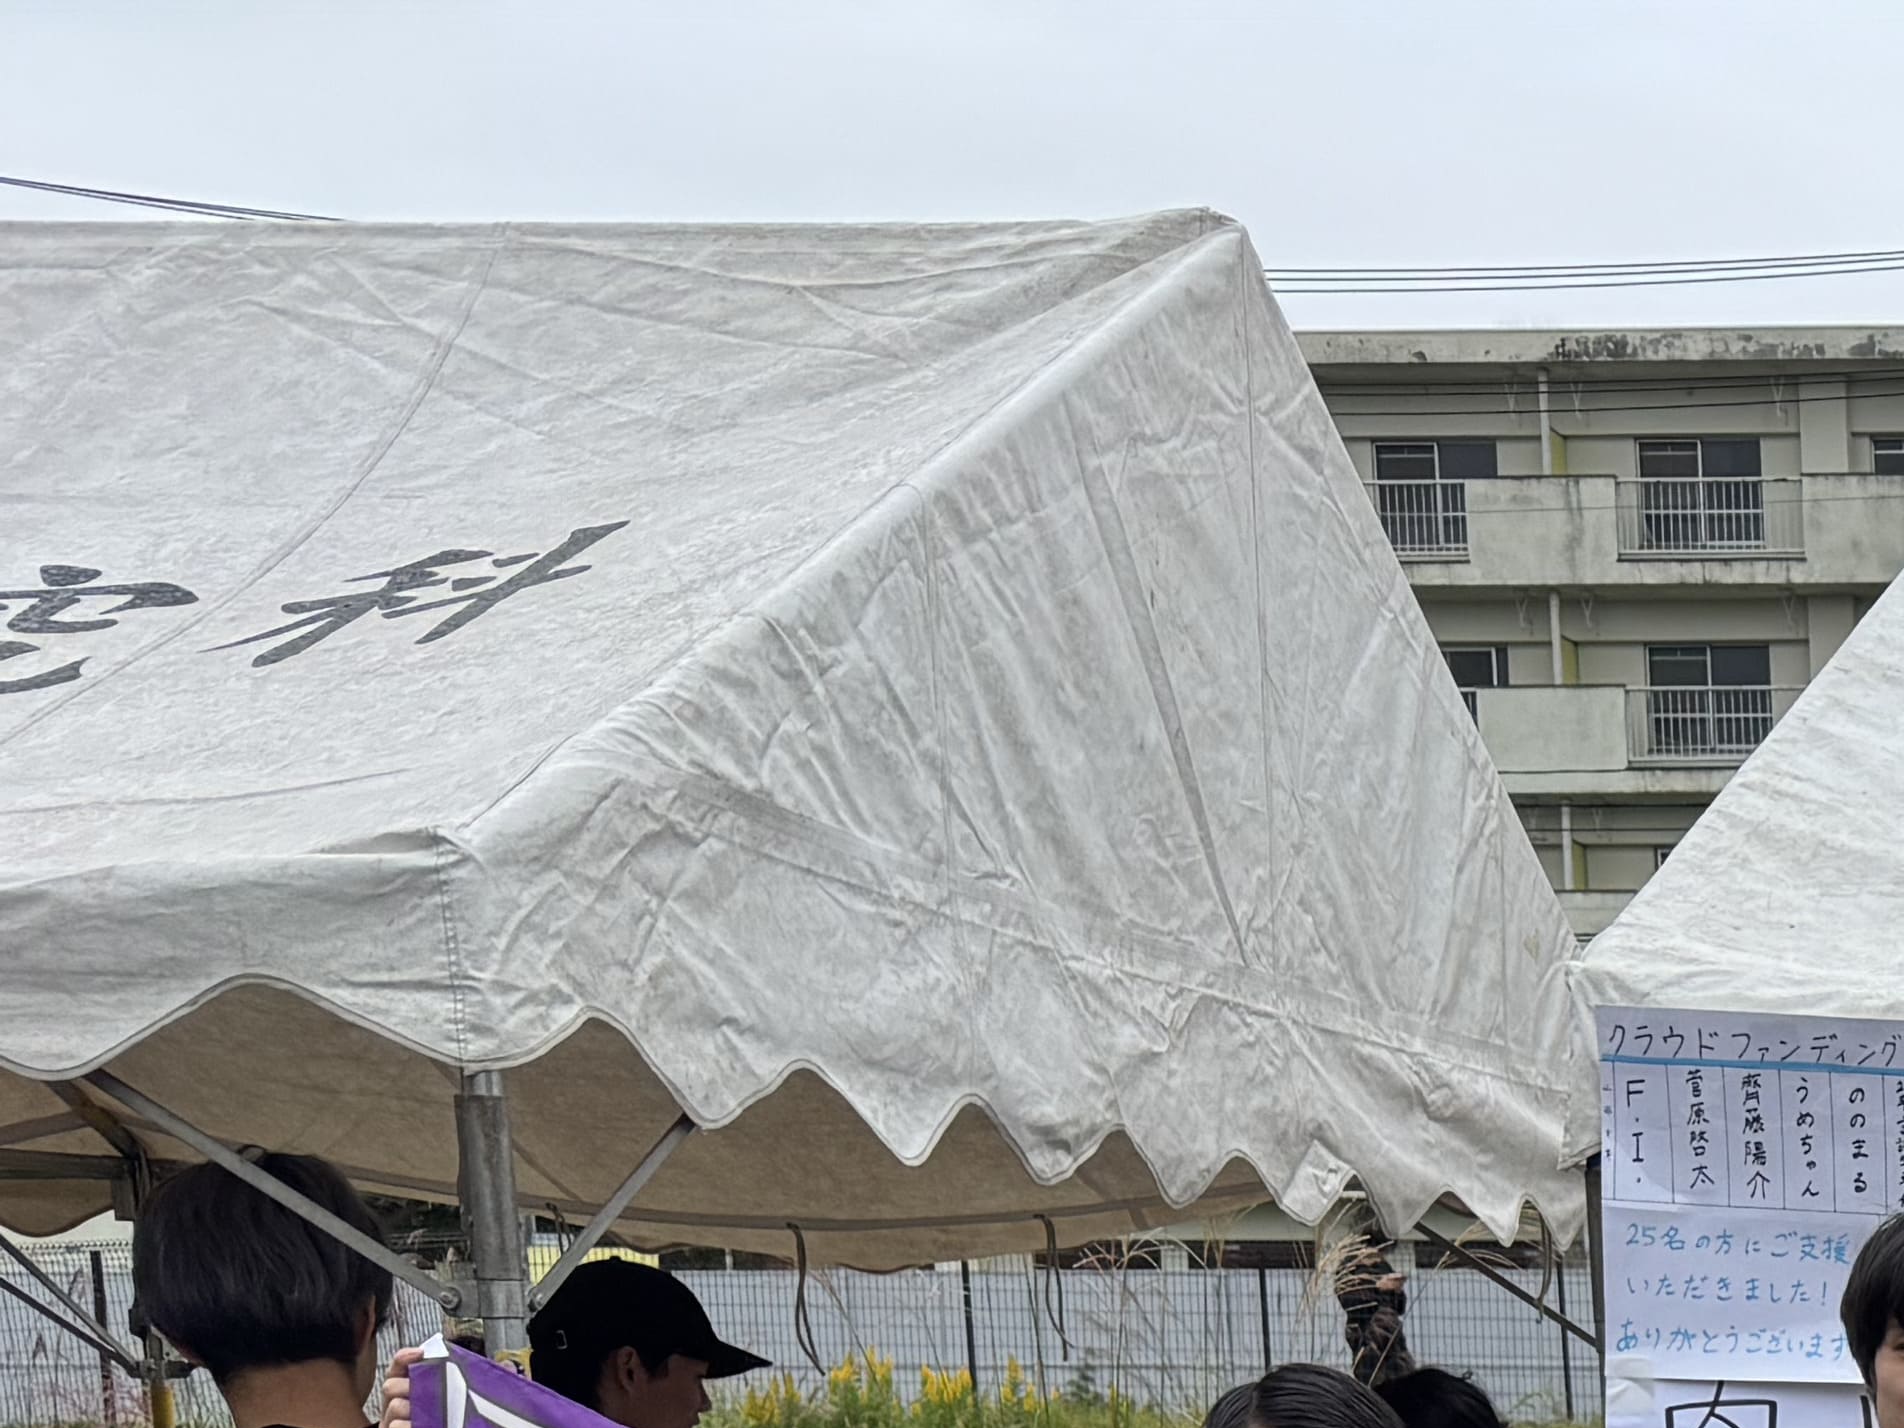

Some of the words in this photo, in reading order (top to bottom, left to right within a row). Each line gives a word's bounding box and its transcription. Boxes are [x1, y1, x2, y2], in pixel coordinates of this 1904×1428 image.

[1796, 1077, 1819, 1197] うめちゃん
[1848, 1087, 1868, 1193] ののまる
